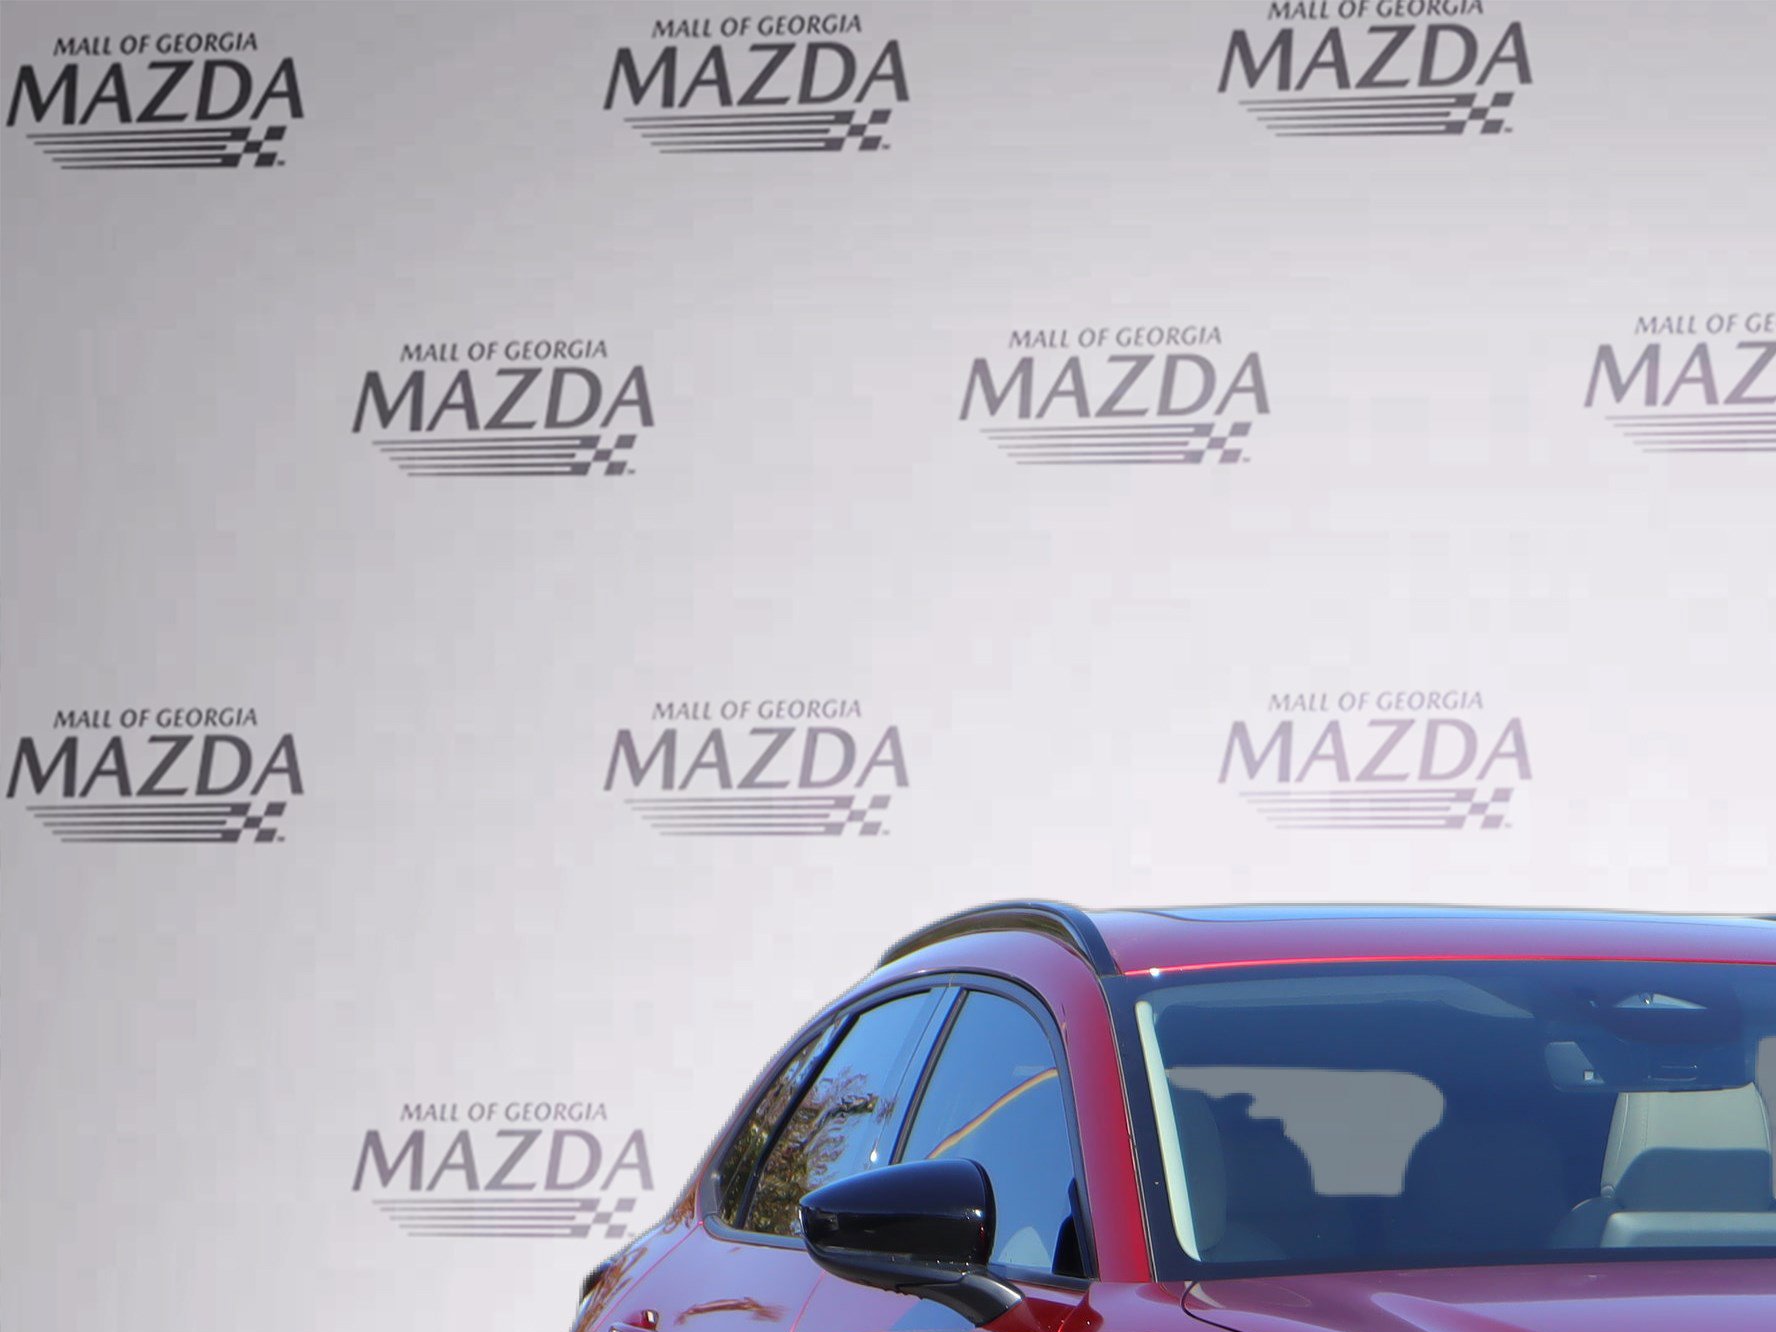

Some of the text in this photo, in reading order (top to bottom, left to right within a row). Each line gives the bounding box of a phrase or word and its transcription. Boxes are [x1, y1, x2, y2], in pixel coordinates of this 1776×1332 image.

[1268, 0, 1483, 19] MALL OF GEORGIA
[652, 14, 861, 38] MALL OF GEORGIA
[53, 32, 257, 56] MALL OF GEORGIA
[1218, 21, 1532, 93] MAZDA
[604, 40, 909, 110] MAZDA
[6, 57, 304, 127] MAZDA
[1636, 315, 1696, 334] MALL
[1706, 314, 1738, 334] OF
[1009, 326, 1221, 348] MALL OF GEORGIA
[400, 340, 607, 362] MALL OF GEORGIA
[959, 352, 1270, 420] MAZDA
[352, 365, 654, 433] MAZDA
[654, 699, 861, 720] MALL OF GEORGIA
[1269, 690, 1483, 712] MALL OF GEORGIA
[53, 707, 257, 728] MALL OF GEORGIA
[604, 726, 909, 791] MAZDA
[1218, 717, 1532, 784] MAZDA
[6, 734, 304, 798] MAZDA
[401, 1102, 607, 1122] MALL OF GEORGIA
[352, 1129, 653, 1192] MAZDA
